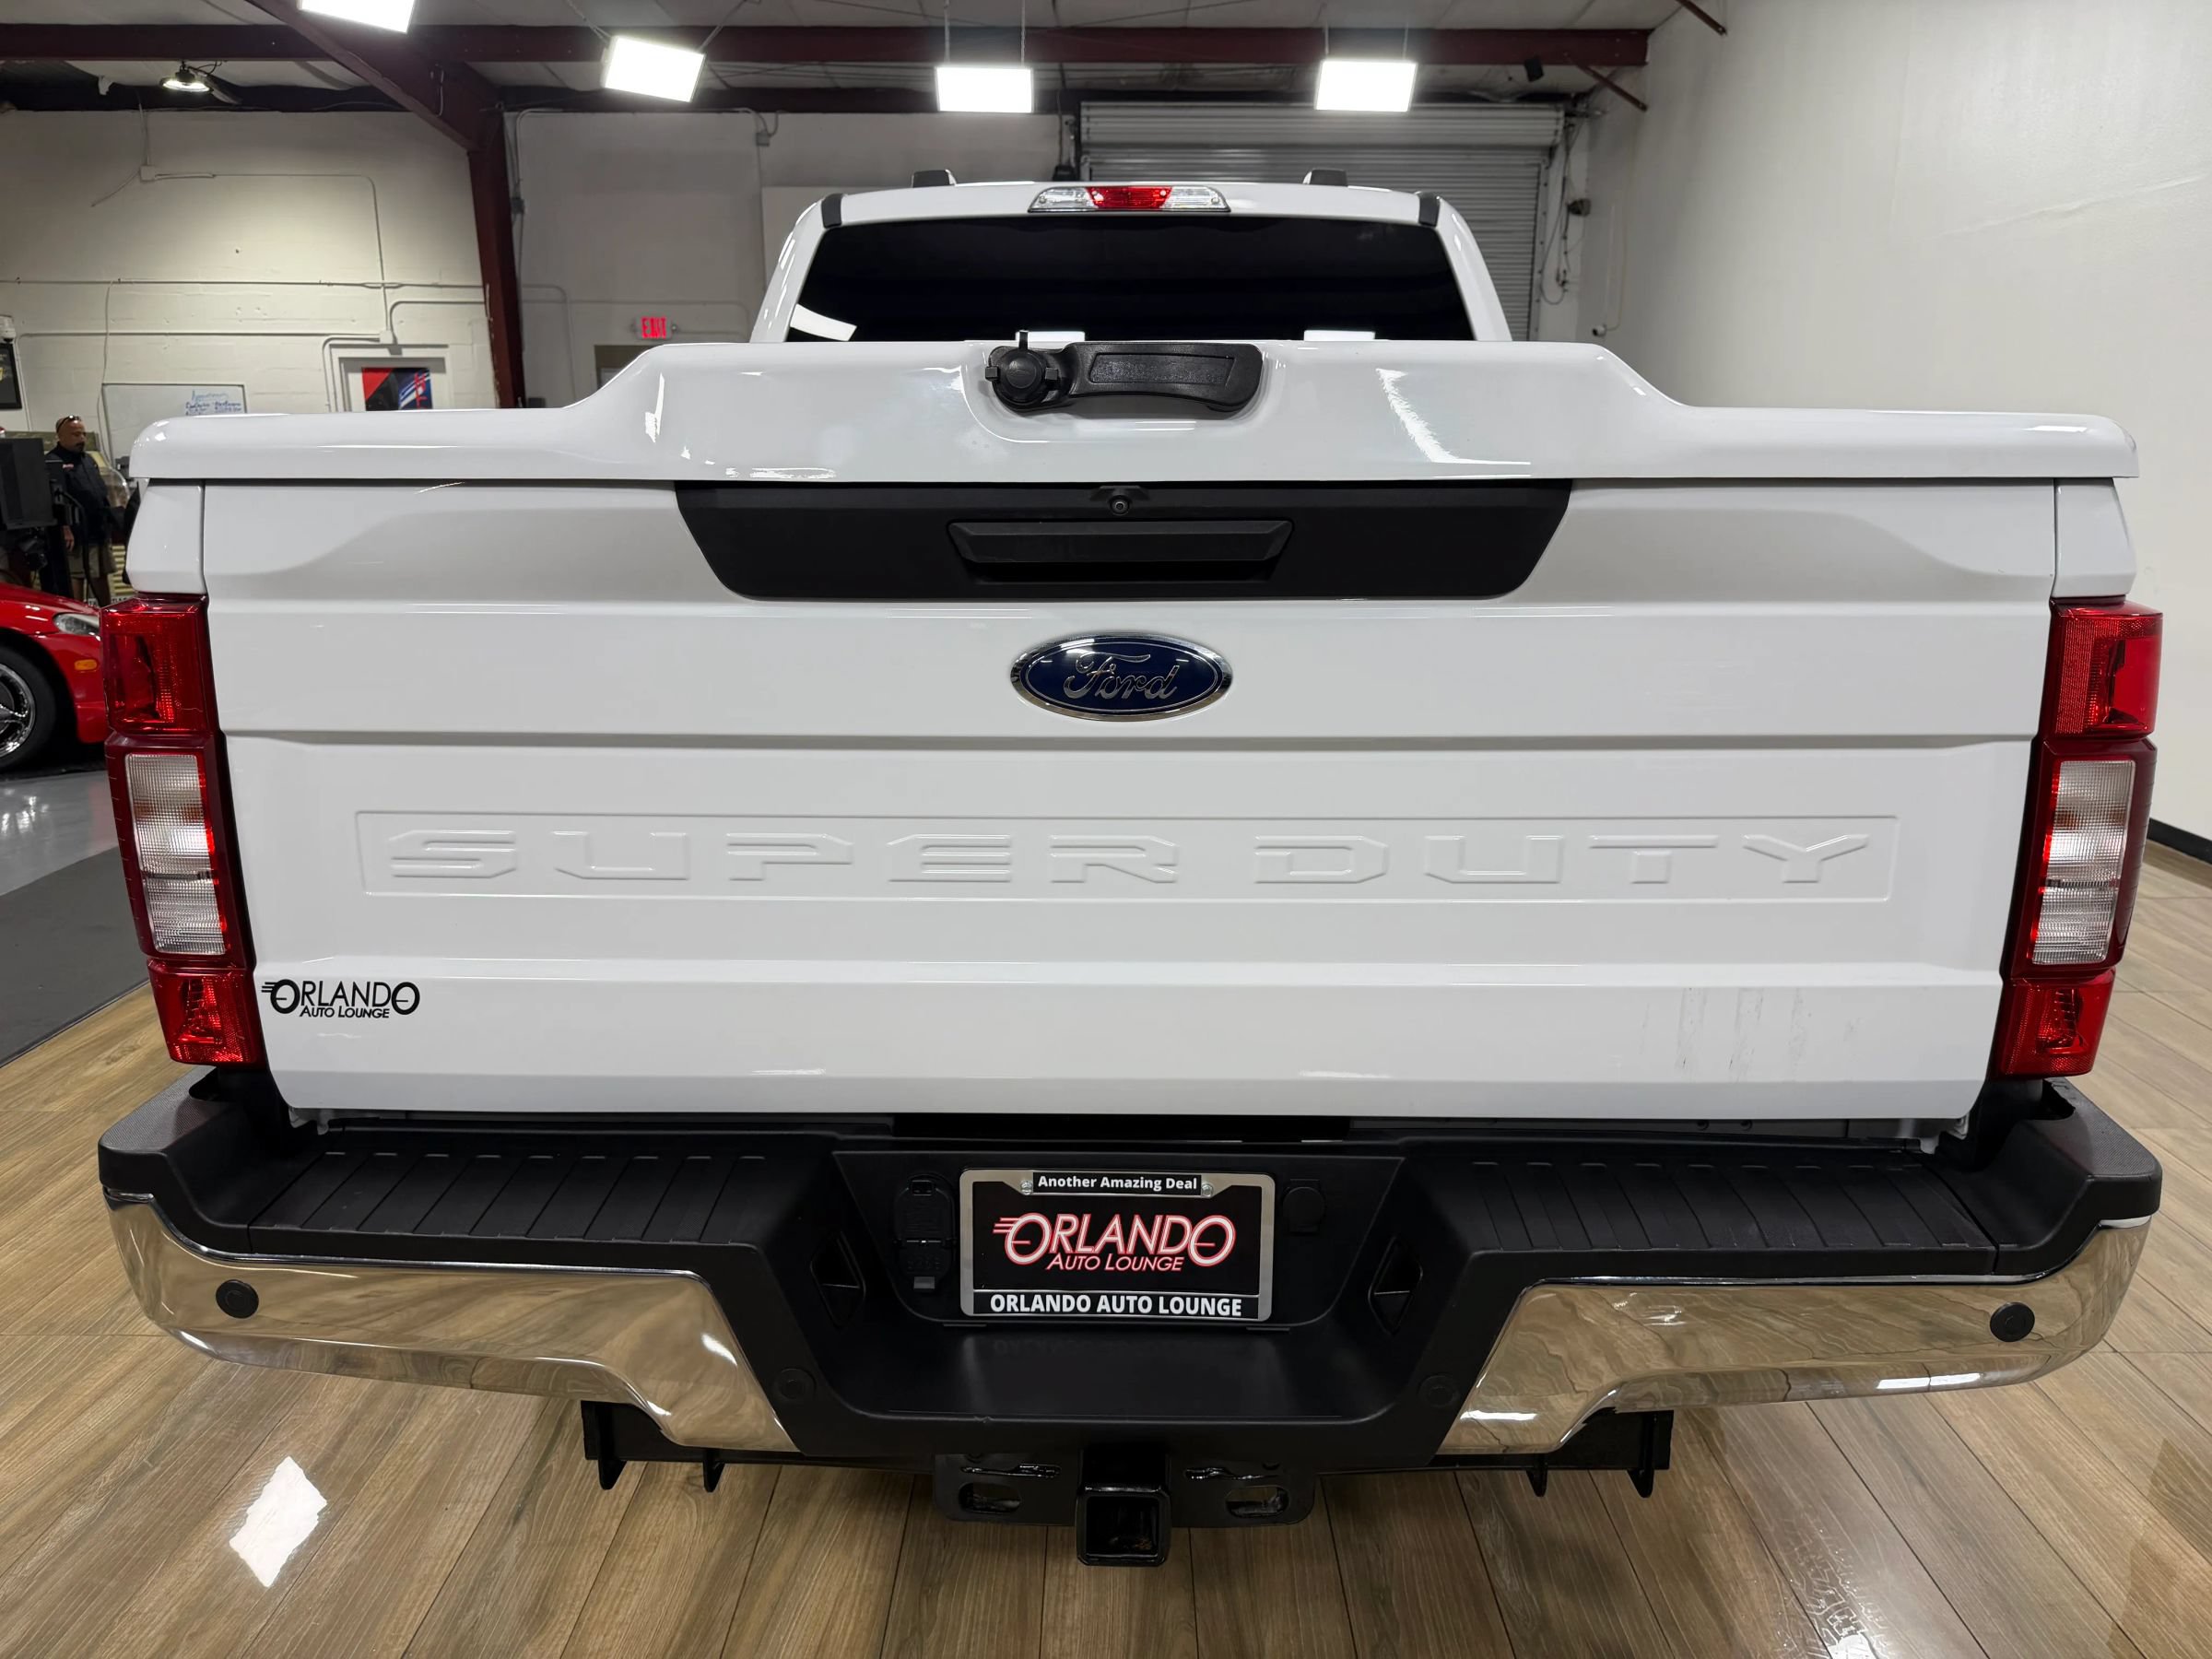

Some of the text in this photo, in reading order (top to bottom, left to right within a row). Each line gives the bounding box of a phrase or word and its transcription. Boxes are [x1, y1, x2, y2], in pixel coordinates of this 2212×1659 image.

[641, 316, 666, 339] EXIT
[1063, 652, 1180, 700] Ford
[388, 830, 1869, 885] SUPER DUTY
[262, 979, 420, 1015] ORLANDO
[1038, 1175, 1197, 1192] Another Amazing Deal
[994, 1212, 1237, 1266] ORLANDO
[990, 1294, 1242, 1316] ORLANDO AUTO LOUNGE
